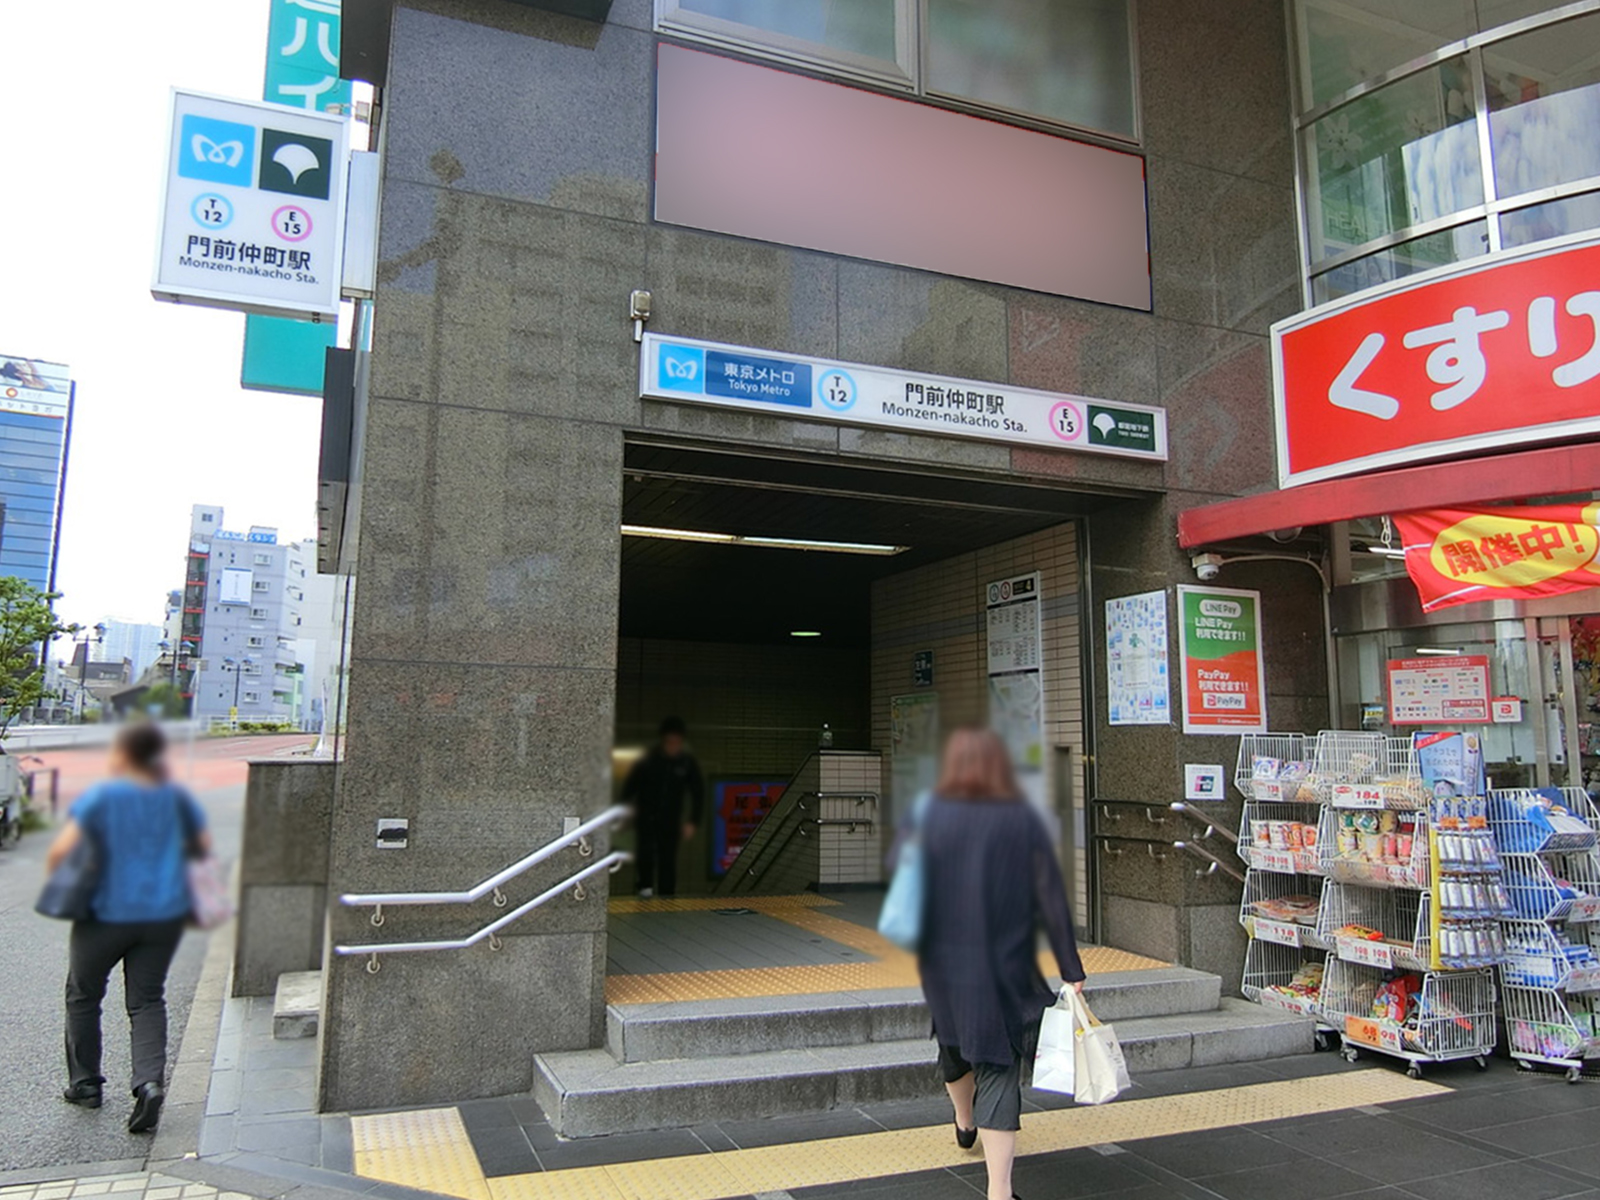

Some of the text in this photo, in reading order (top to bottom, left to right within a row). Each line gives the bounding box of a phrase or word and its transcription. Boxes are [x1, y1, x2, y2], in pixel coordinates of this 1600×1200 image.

[209, 199, 218, 209] T
[204, 209, 223, 223] 12
[289, 211, 297, 222] E
[284, 222, 302, 235] 15
[186, 234, 312, 271] 門前仲町駅
[178, 255, 320, 285] Monzen-nakacho Sta.
[1328, 290, 1600, 420] くすり
[723, 361, 795, 385] 東京メトロ
[729, 378, 791, 397] Tokyo Metro
[833, 376, 842, 387] T
[829, 388, 848, 404] 12
[905, 382, 1005, 415] 門前仲町駅
[882, 401, 1028, 433] Monzen-nakacho Sta.
[1062, 408, 1070, 420] E
[1058, 420, 1075, 434] 15
[1441, 522, 1586, 577] 開催中!
[1194, 617, 1233, 630] LINE Pay
[1197, 669, 1230, 680] PayPay
[1217, 697, 1242, 707] PayPay
[1356, 791, 1380, 800] 184
[1363, 1025, 1377, 1036] 68
